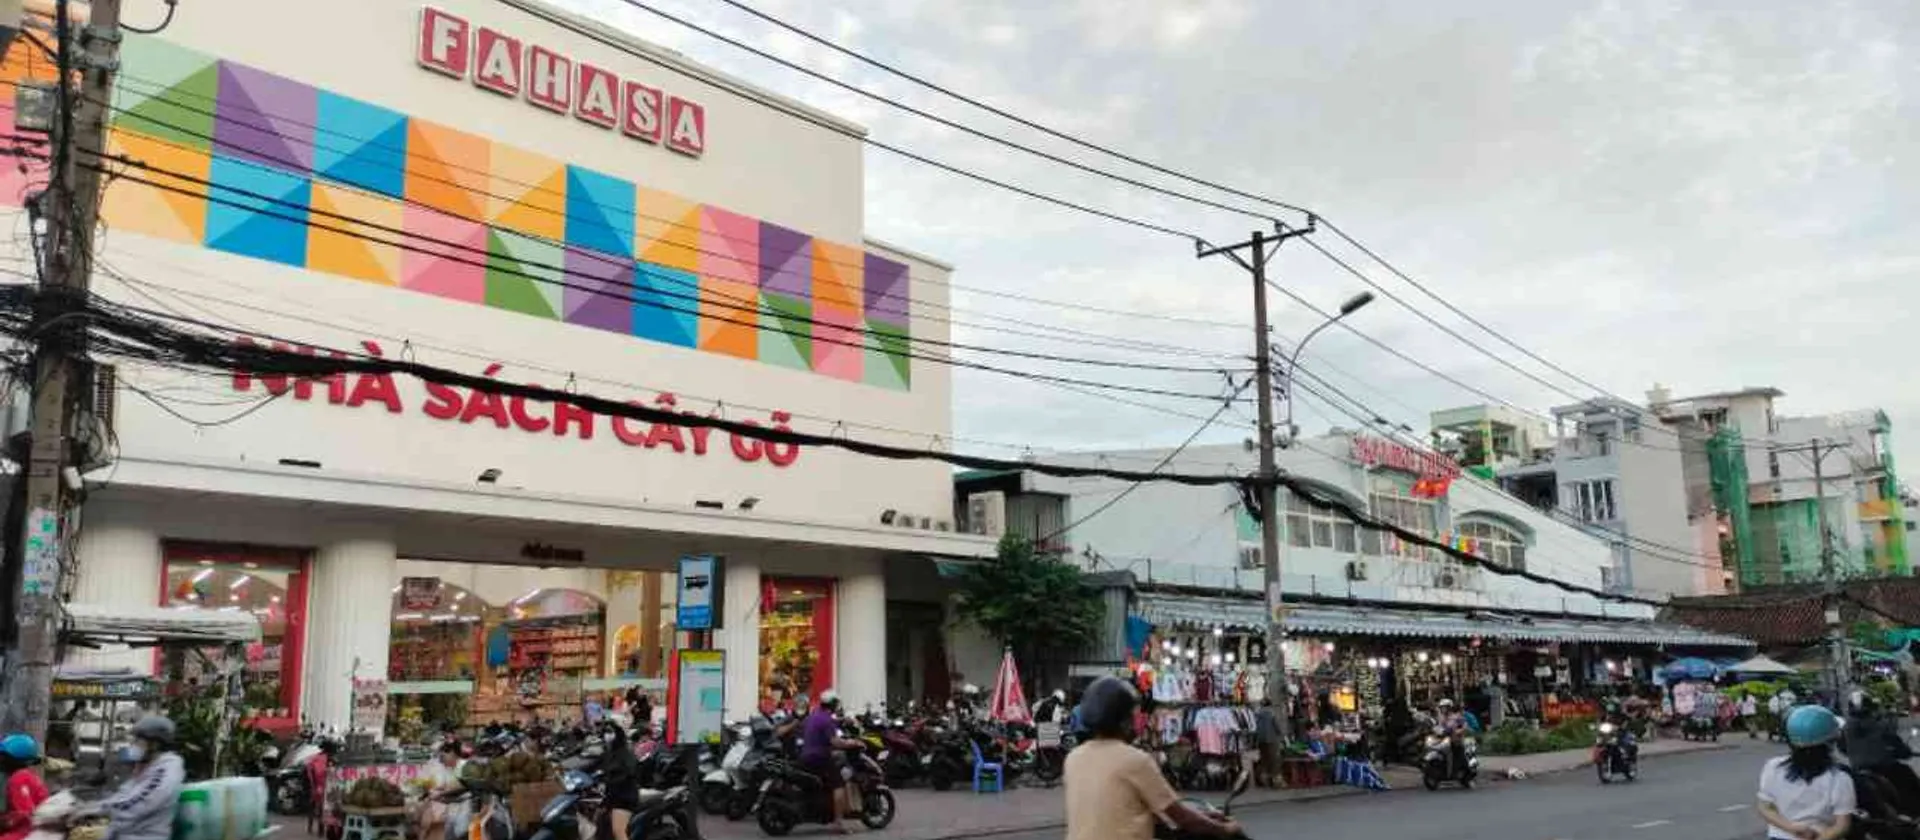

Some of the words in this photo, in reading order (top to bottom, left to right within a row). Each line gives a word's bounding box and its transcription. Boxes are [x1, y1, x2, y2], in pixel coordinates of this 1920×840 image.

[428, 12, 703, 150] FAHASA
[423, 363, 593, 439] SÁCH
[612, 393, 719, 455] CÂY
